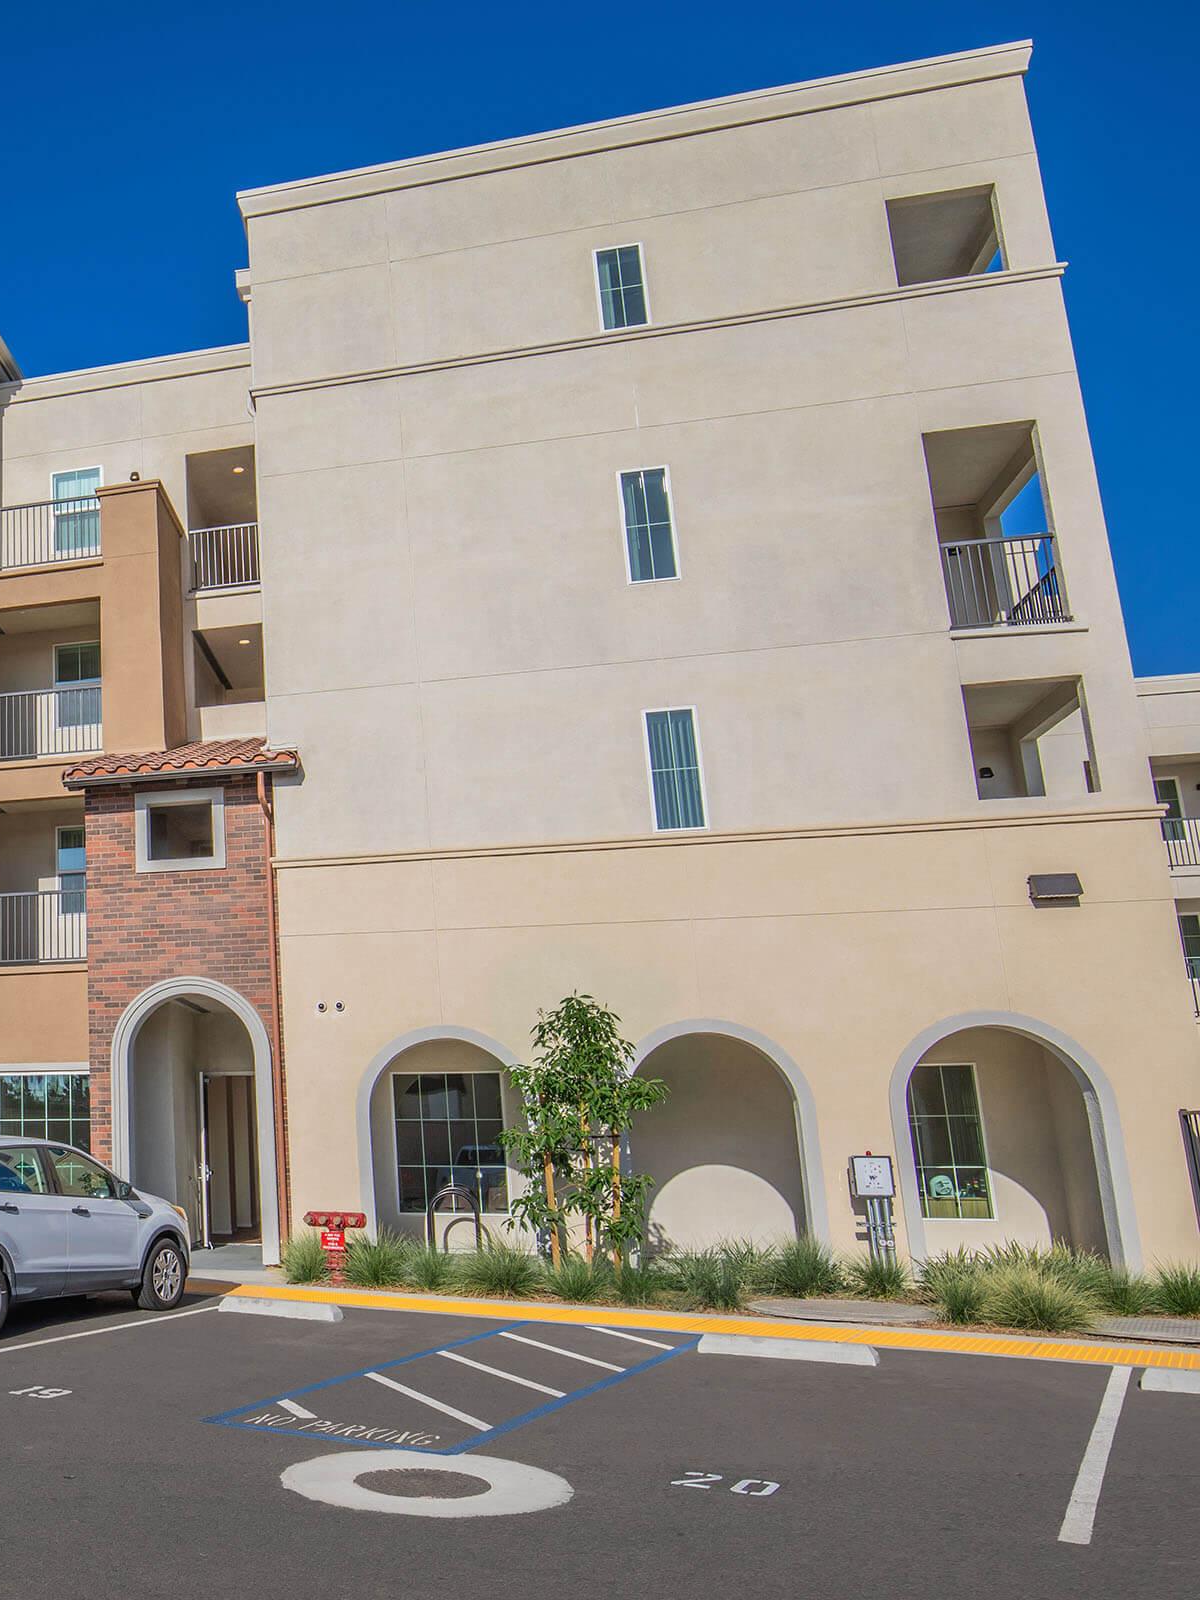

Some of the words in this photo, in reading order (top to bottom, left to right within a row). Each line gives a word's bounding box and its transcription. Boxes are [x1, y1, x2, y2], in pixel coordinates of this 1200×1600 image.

[8, 1386, 73, 1399] 19
[244, 1413, 297, 1427] NO
[298, 1419, 441, 1446] PARKING
[670, 1471, 780, 1496] 20
